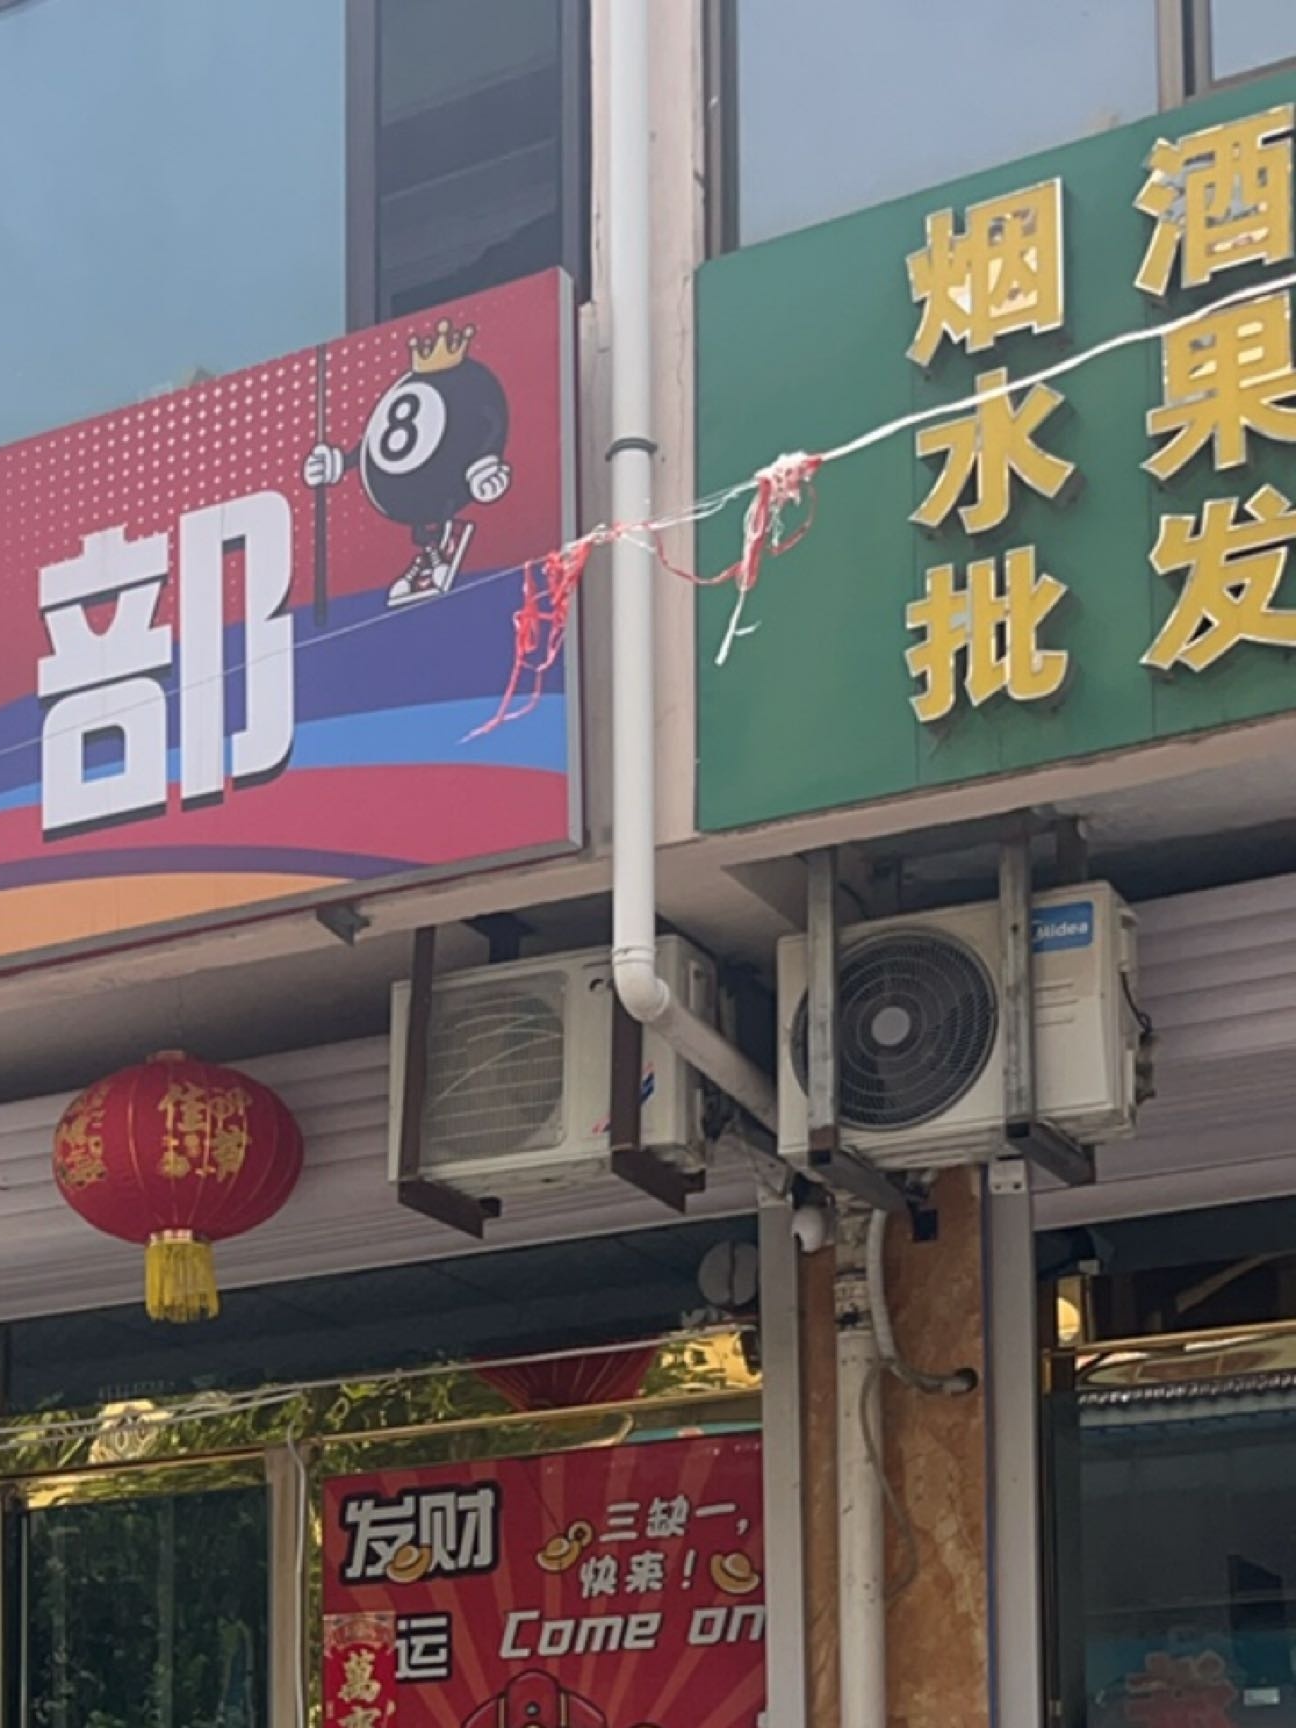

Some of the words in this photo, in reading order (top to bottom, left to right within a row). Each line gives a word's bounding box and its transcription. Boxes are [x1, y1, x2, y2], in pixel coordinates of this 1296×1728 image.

[345, 1488, 495, 1579] 发财
[395, 1616, 448, 1679] 运
[498, 1610, 662, 1659] Come
[688, 1604, 766, 1645] on
